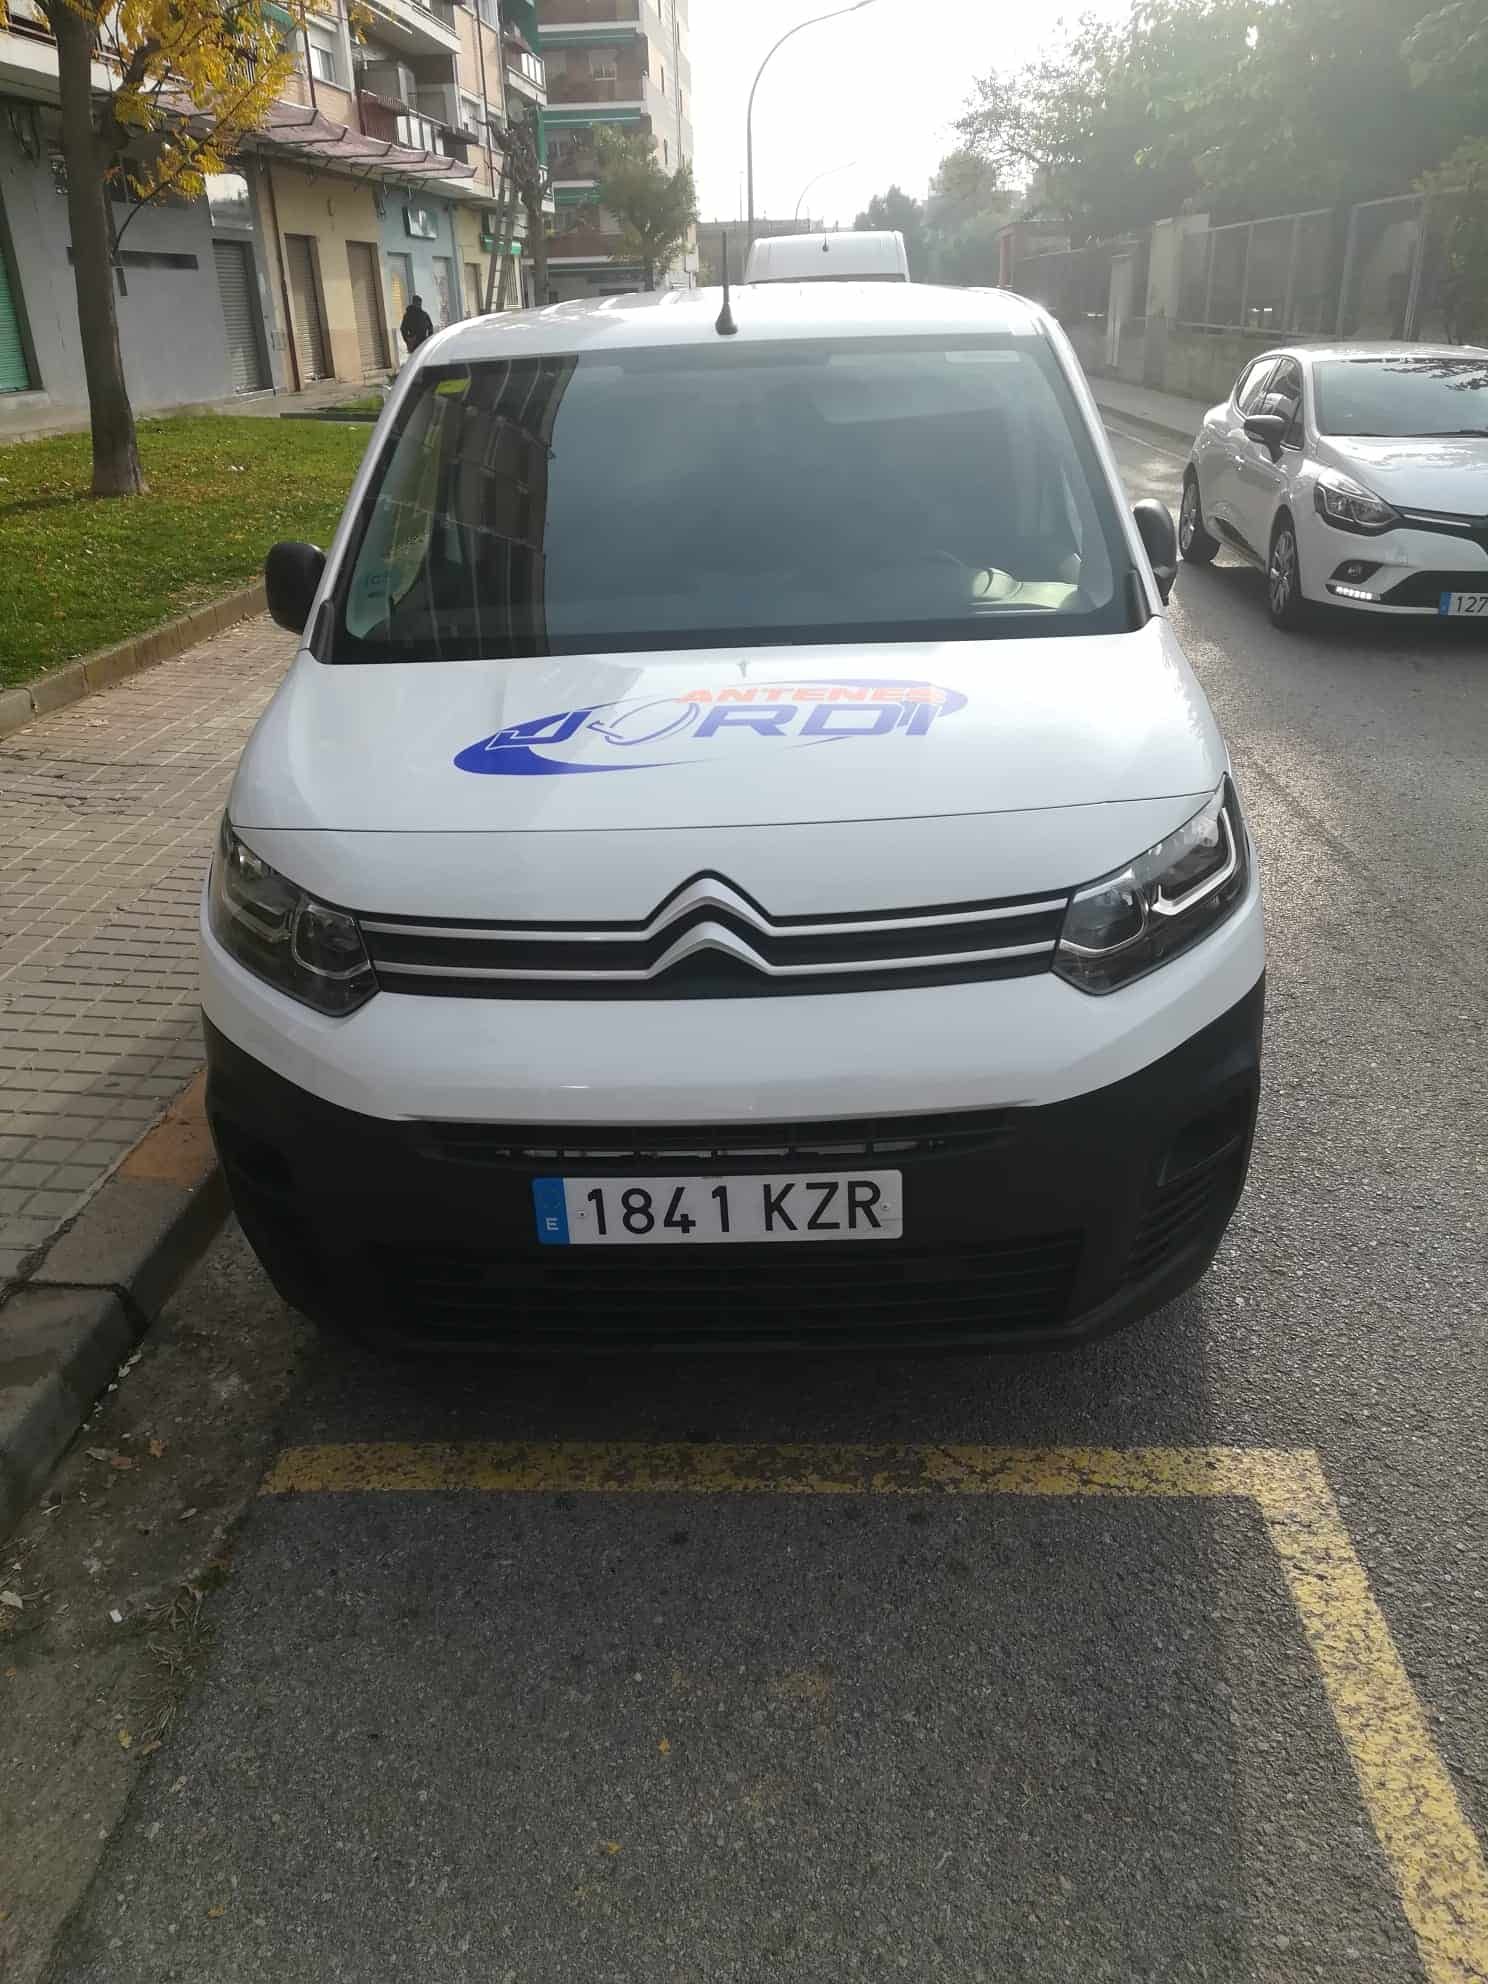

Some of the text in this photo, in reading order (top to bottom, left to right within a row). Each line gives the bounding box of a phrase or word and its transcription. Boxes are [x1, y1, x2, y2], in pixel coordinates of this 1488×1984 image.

[1457, 596, 1488, 613] 127
[673, 687, 945, 704] ANTENES
[587, 1180, 882, 1236] 1841 KZR
[546, 1217, 559, 1231] E
